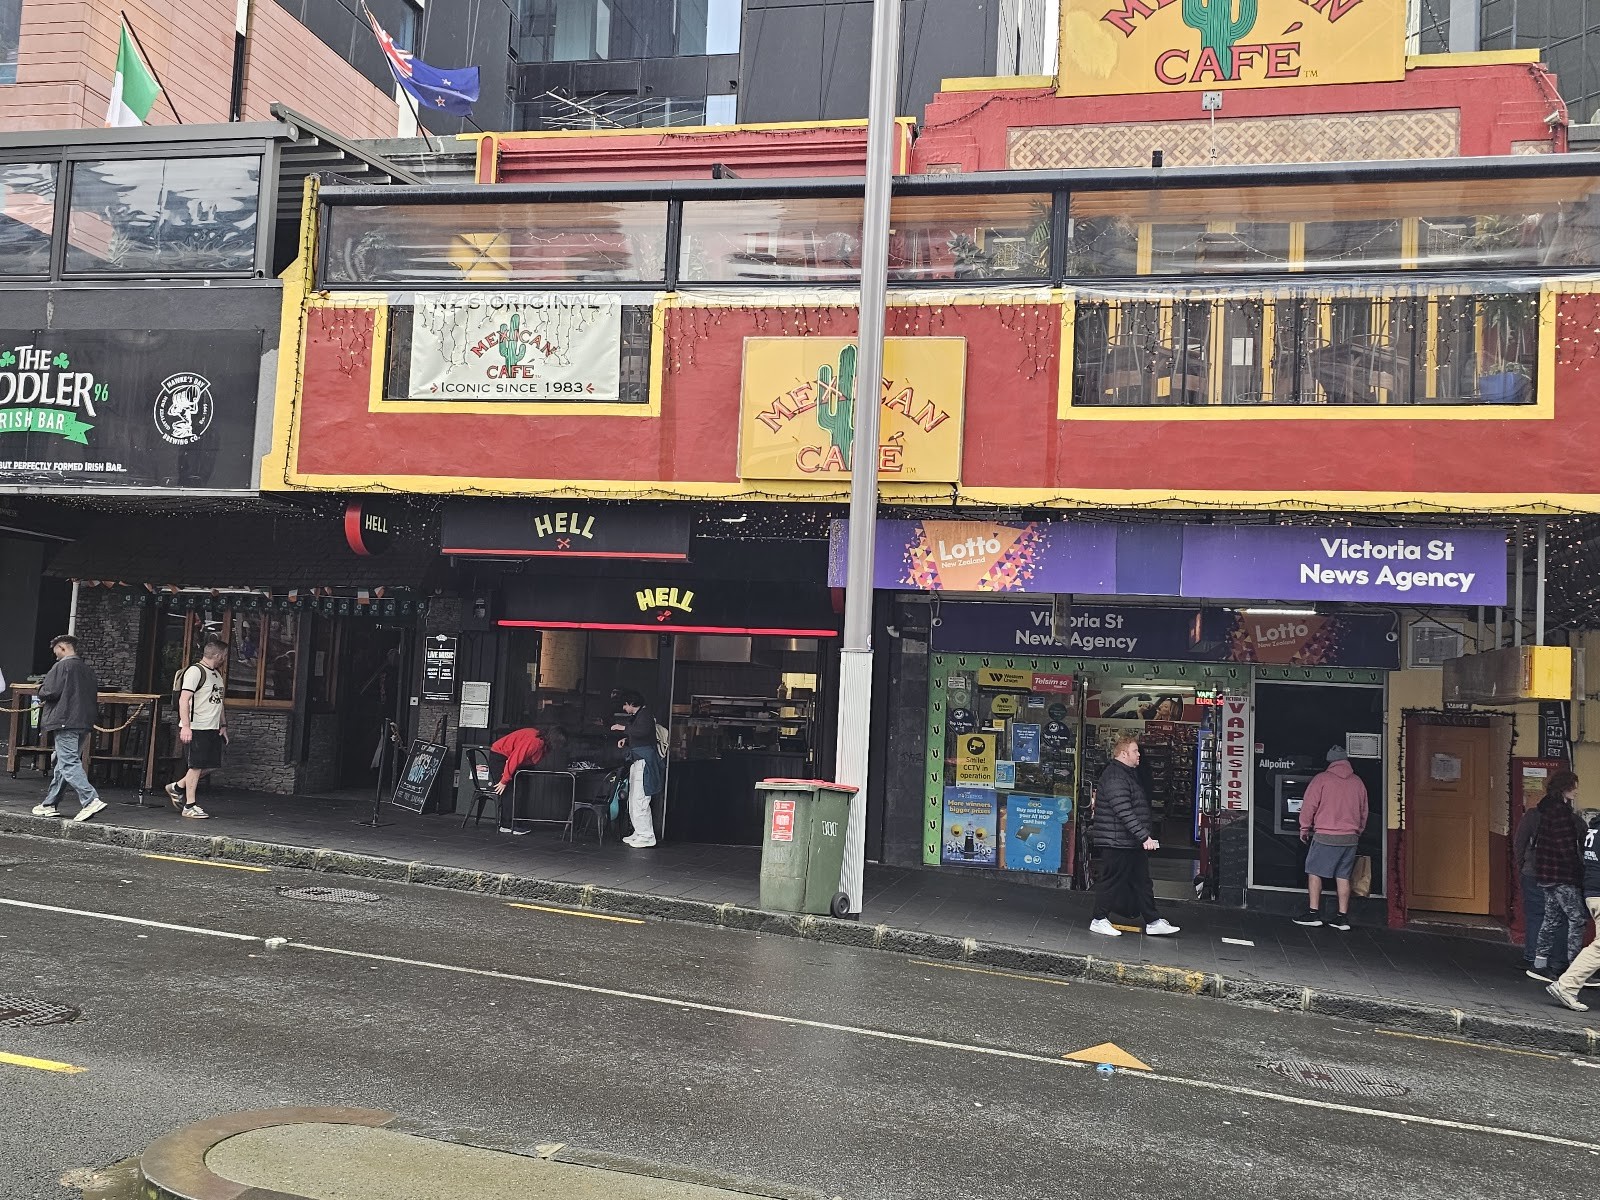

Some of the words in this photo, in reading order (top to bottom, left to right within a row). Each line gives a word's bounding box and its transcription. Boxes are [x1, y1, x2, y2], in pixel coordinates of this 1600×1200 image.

[1154, 22, 1301, 85] CAFÉ
[470, 328, 557, 358] MEXICAN
[15, 345, 53, 370] THE
[486, 358, 535, 379] CAFÉ
[166, 375, 193, 388] HAWKE'S
[193, 378, 205, 388] BAY
[441, 382, 494, 393] ICONIC
[496, 383, 538, 393] SINCE
[545, 382, 583, 393] 1983
[94, 383, 109, 401] 96
[755, 376, 950, 433] MEXAN
[37, 412, 65, 431] BAR
[162, 433, 189, 445] BREWING
[796, 431, 903, 473] CAÉ
[13, 461, 52, 471] PERFECTLY
[53, 462, 83, 471] FORMED
[84, 462, 104, 471] IRISH
[365, 514, 388, 534] HELL
[534, 512, 596, 539] HELL
[938, 536, 1001, 561] Lotto
[1320, 538, 1421, 560] Victoria
[1426, 539, 1455, 561] St
[941, 560, 957, 569] New
[957, 556, 986, 568] Zealand
[1300, 564, 1368, 585] News
[1375, 566, 1475, 592] Agency
[635, 587, 696, 613] HELL
[1105, 613, 1124, 629] St
[1069, 632, 1138, 652] Agency
[1254, 622, 1309, 643] Lotto
[1257, 640, 1272, 649] New
[1272, 638, 1296, 648] Zealand
[427, 650, 438, 658] LIVE
[438, 651, 454, 659] MUSIC
[966, 756, 986, 764] Smile!
[949, 806, 971, 814] bigger
[971, 807, 991, 815] prizes
